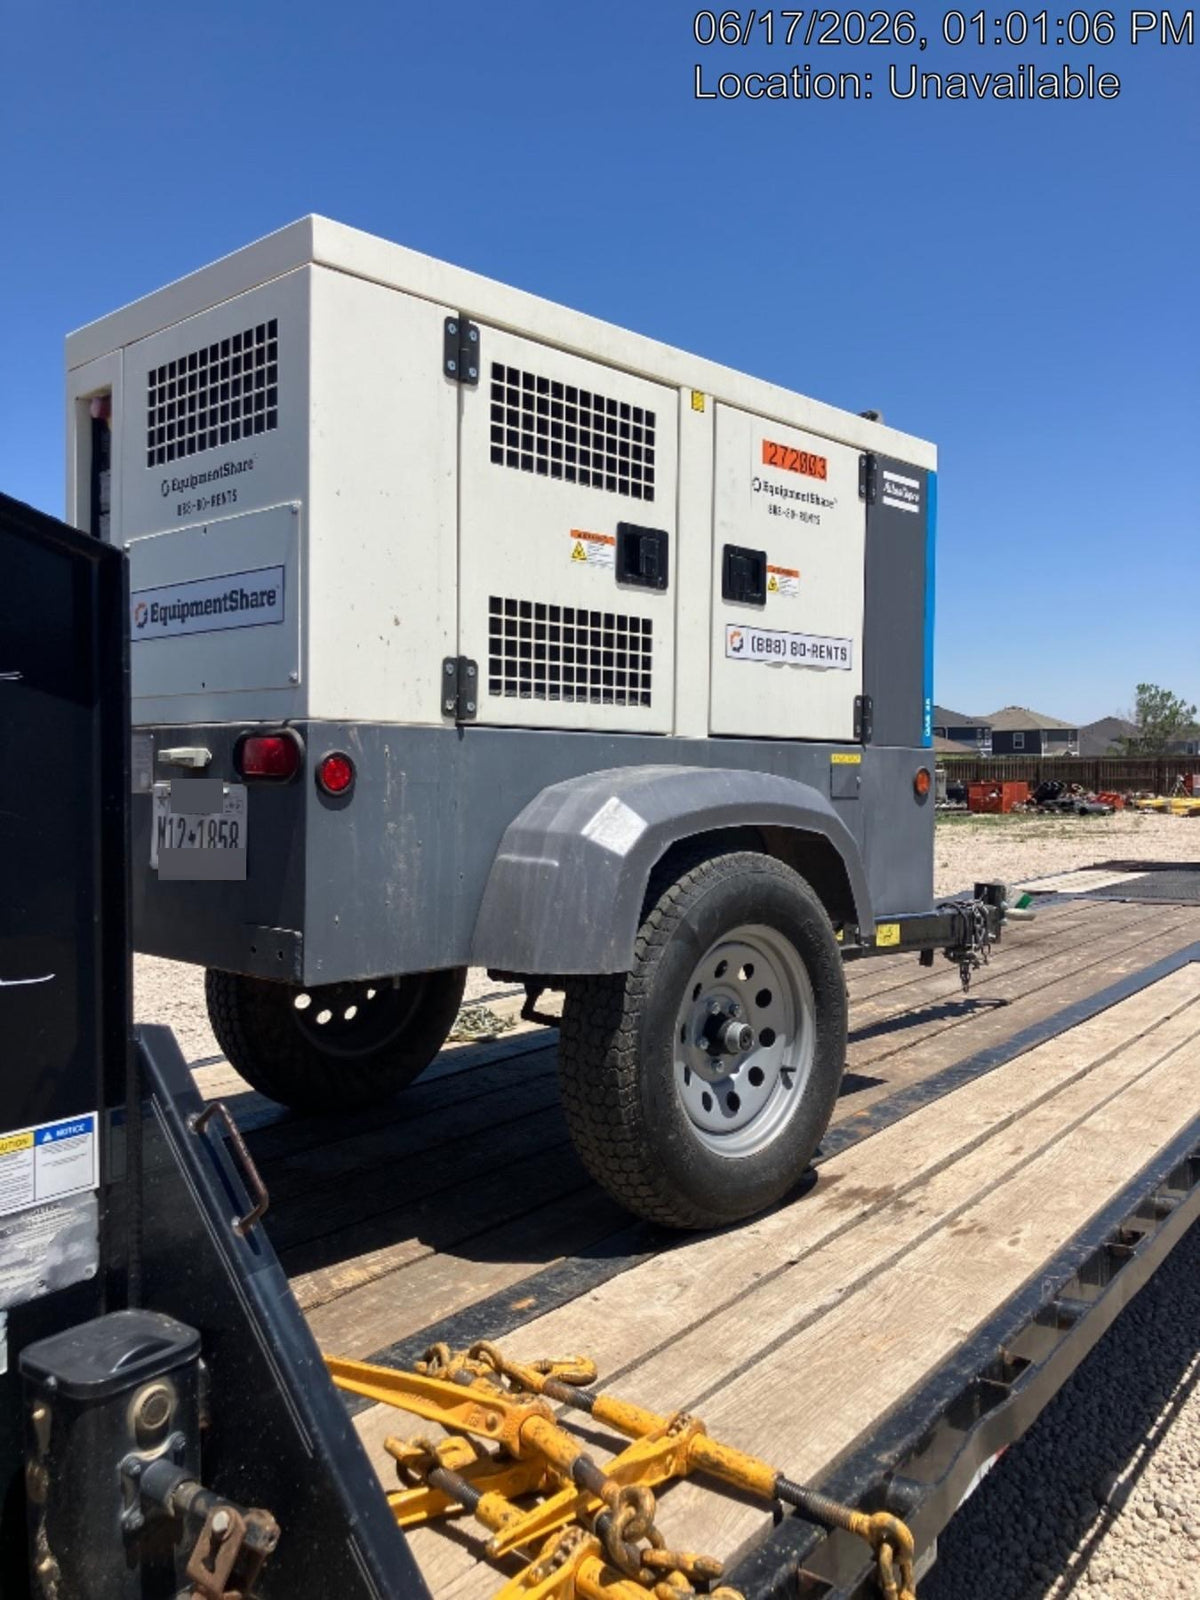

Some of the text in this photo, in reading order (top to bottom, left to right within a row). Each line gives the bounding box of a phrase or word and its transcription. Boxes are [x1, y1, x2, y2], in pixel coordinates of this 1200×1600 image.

[150, 587, 277, 626] EquipmentShare
[751, 635, 848, 661] (888) 80-RENTS
[0, 1136, 28, 1151] UTION
